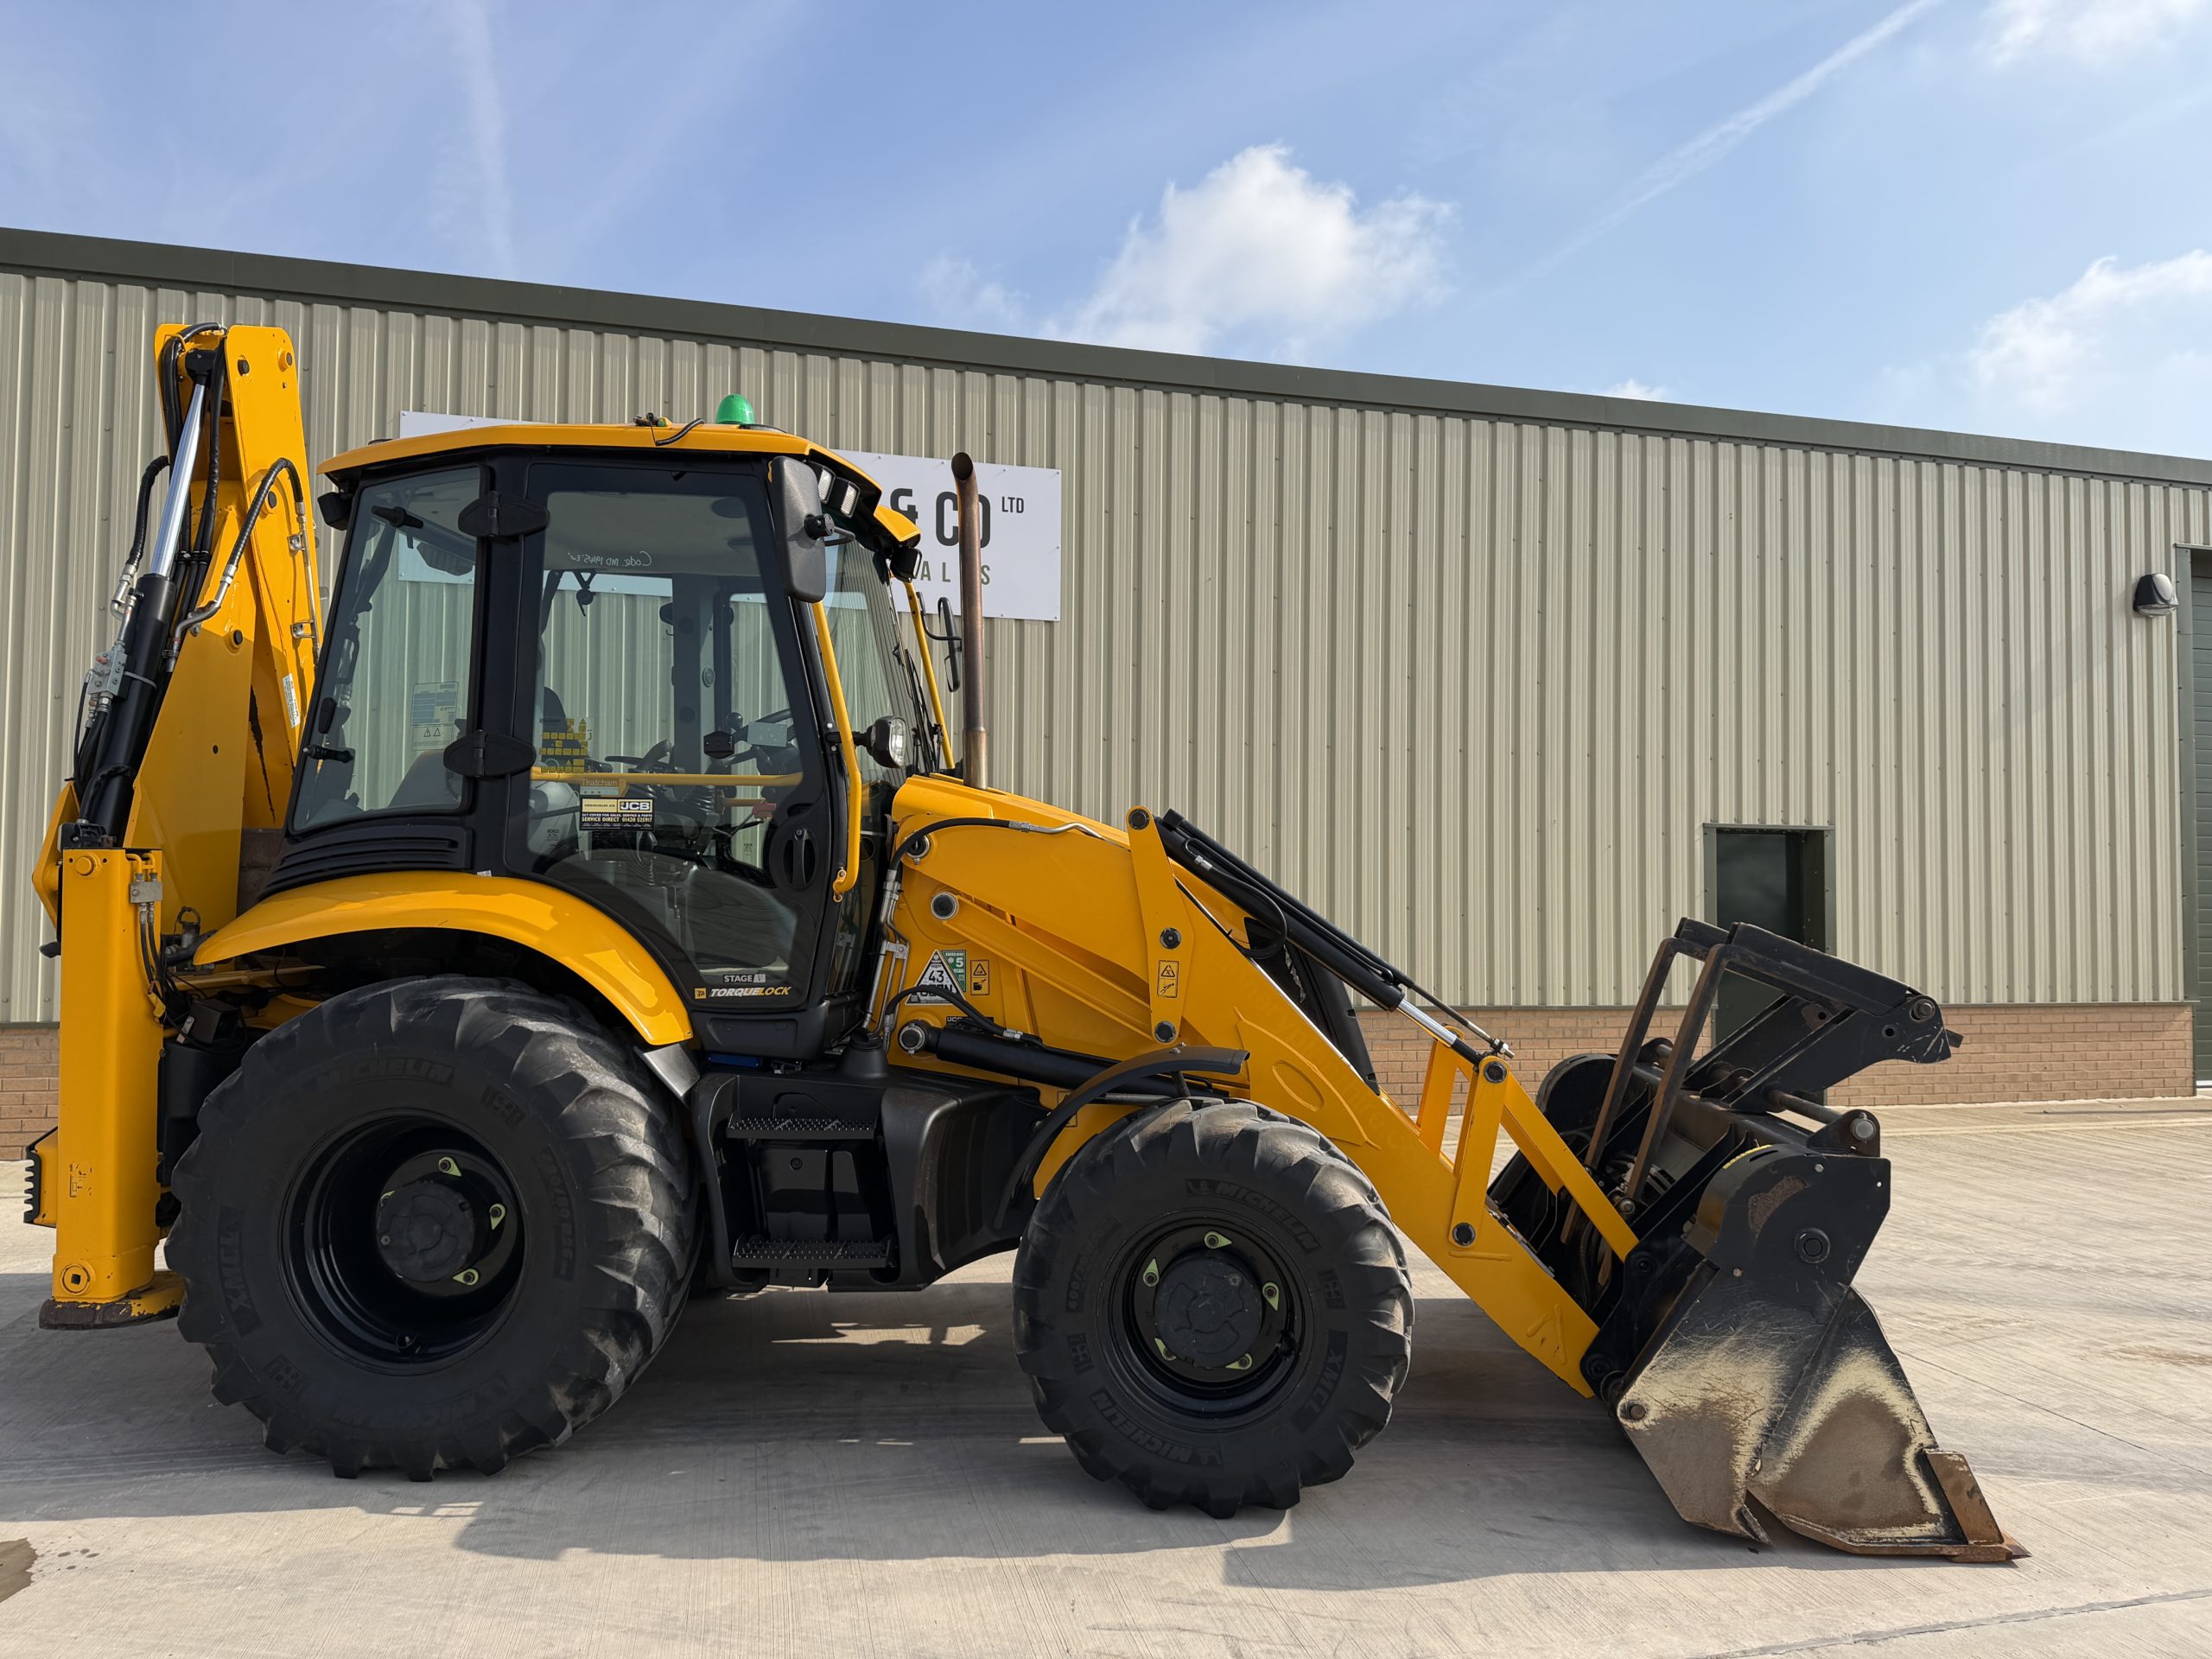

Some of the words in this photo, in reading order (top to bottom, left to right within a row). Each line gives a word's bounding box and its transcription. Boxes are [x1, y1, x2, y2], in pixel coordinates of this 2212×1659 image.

[1001, 496, 1025, 514] LTD
[916, 560, 991, 586] ALS
[620, 802, 650, 810] JCB
[956, 957, 964, 968] 5
[929, 970, 944, 983] 43
[710, 987, 792, 997] TORQUELOCK
[315, 1056, 454, 1090] MICHELIN
[1215, 1182, 1319, 1252] MICHELIN
[219, 1230, 251, 1313] XMCL
[1303, 1349, 1345, 1414] XMCL
[1091, 1389, 1193, 1463] MICHELIN
